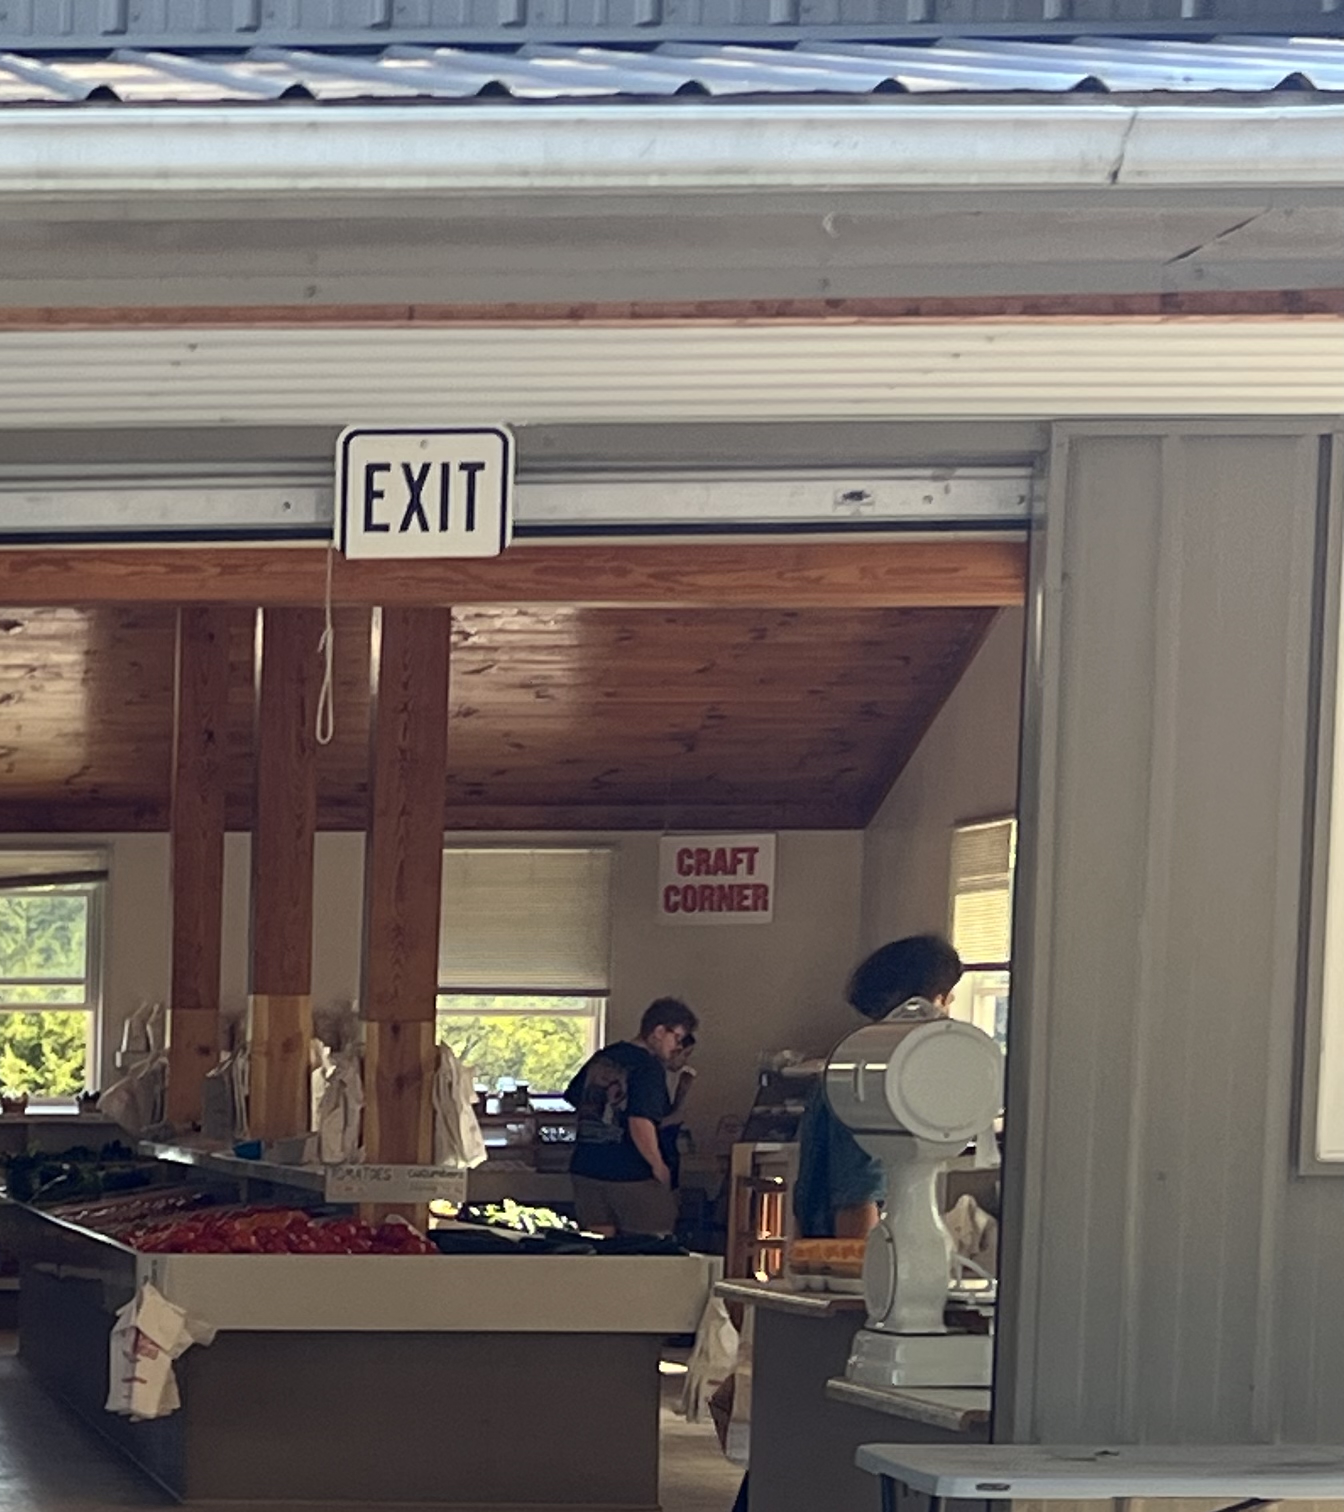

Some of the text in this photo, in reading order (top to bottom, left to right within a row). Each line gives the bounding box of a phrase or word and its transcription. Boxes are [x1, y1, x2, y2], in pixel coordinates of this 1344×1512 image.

[364, 462, 486, 533] EXIT
[676, 846, 760, 877] CRAFT
[663, 883, 769, 914] CORNER
